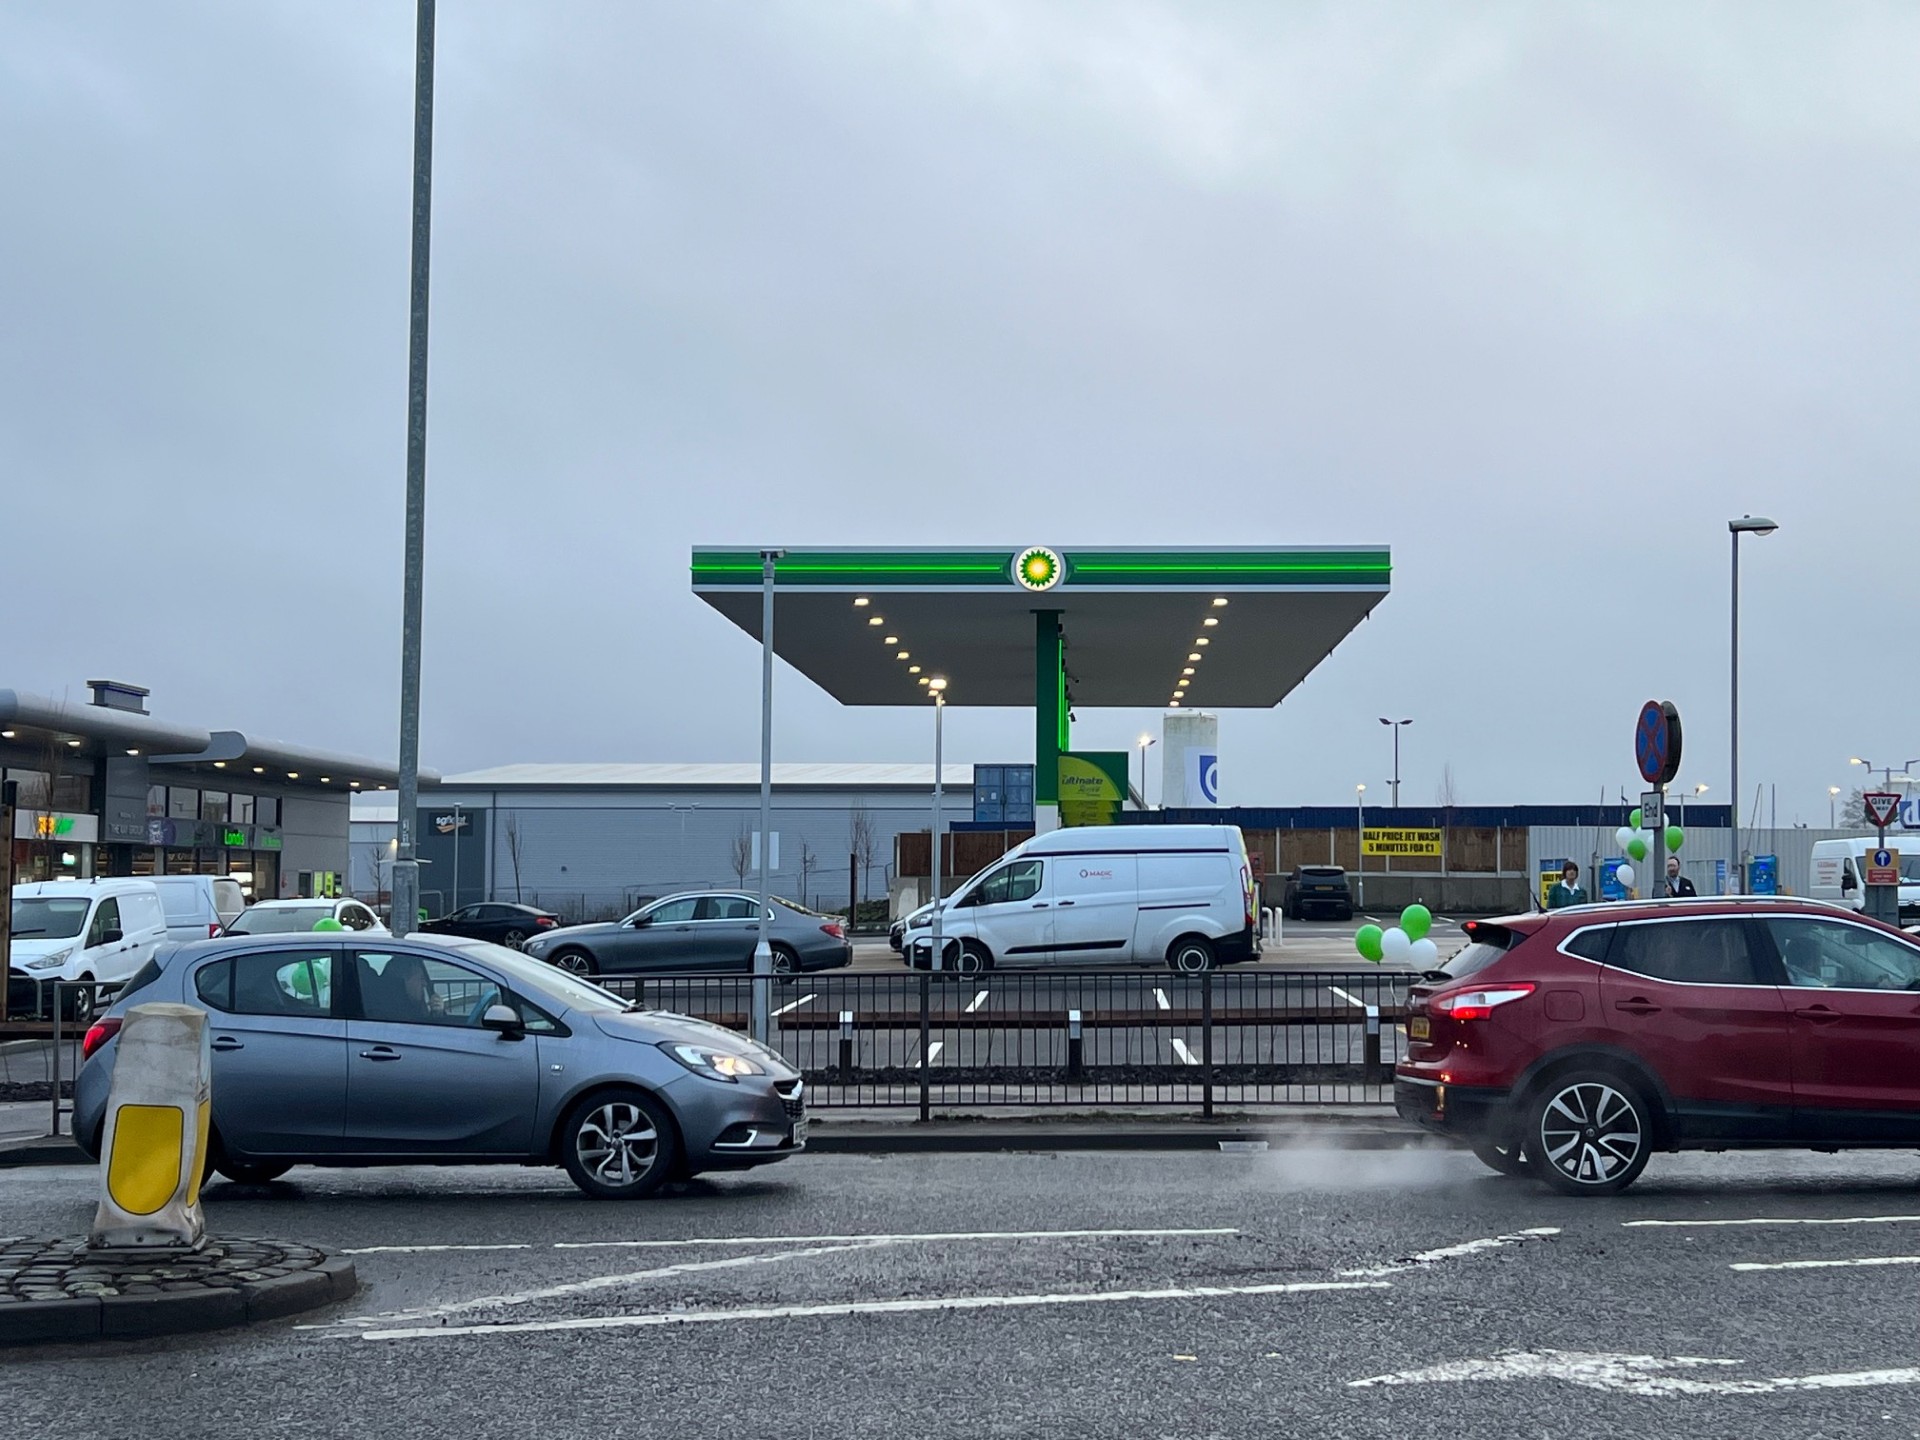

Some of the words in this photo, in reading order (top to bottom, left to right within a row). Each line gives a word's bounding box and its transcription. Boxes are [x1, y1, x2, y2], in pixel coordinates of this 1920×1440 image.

[1062, 776, 1103, 785] ultimate
[1645, 802, 1658, 818] End
[1363, 831, 1380, 841] HALF
[1382, 831, 1403, 841] PRICE
[1405, 831, 1416, 841] JET
[1417, 832, 1440, 841] WASH
[1369, 843, 1374, 852] 5
[1376, 843, 1408, 852] MINUTES
[1410, 843, 1424, 852] FOR
[1425, 844, 1434, 852] £1
